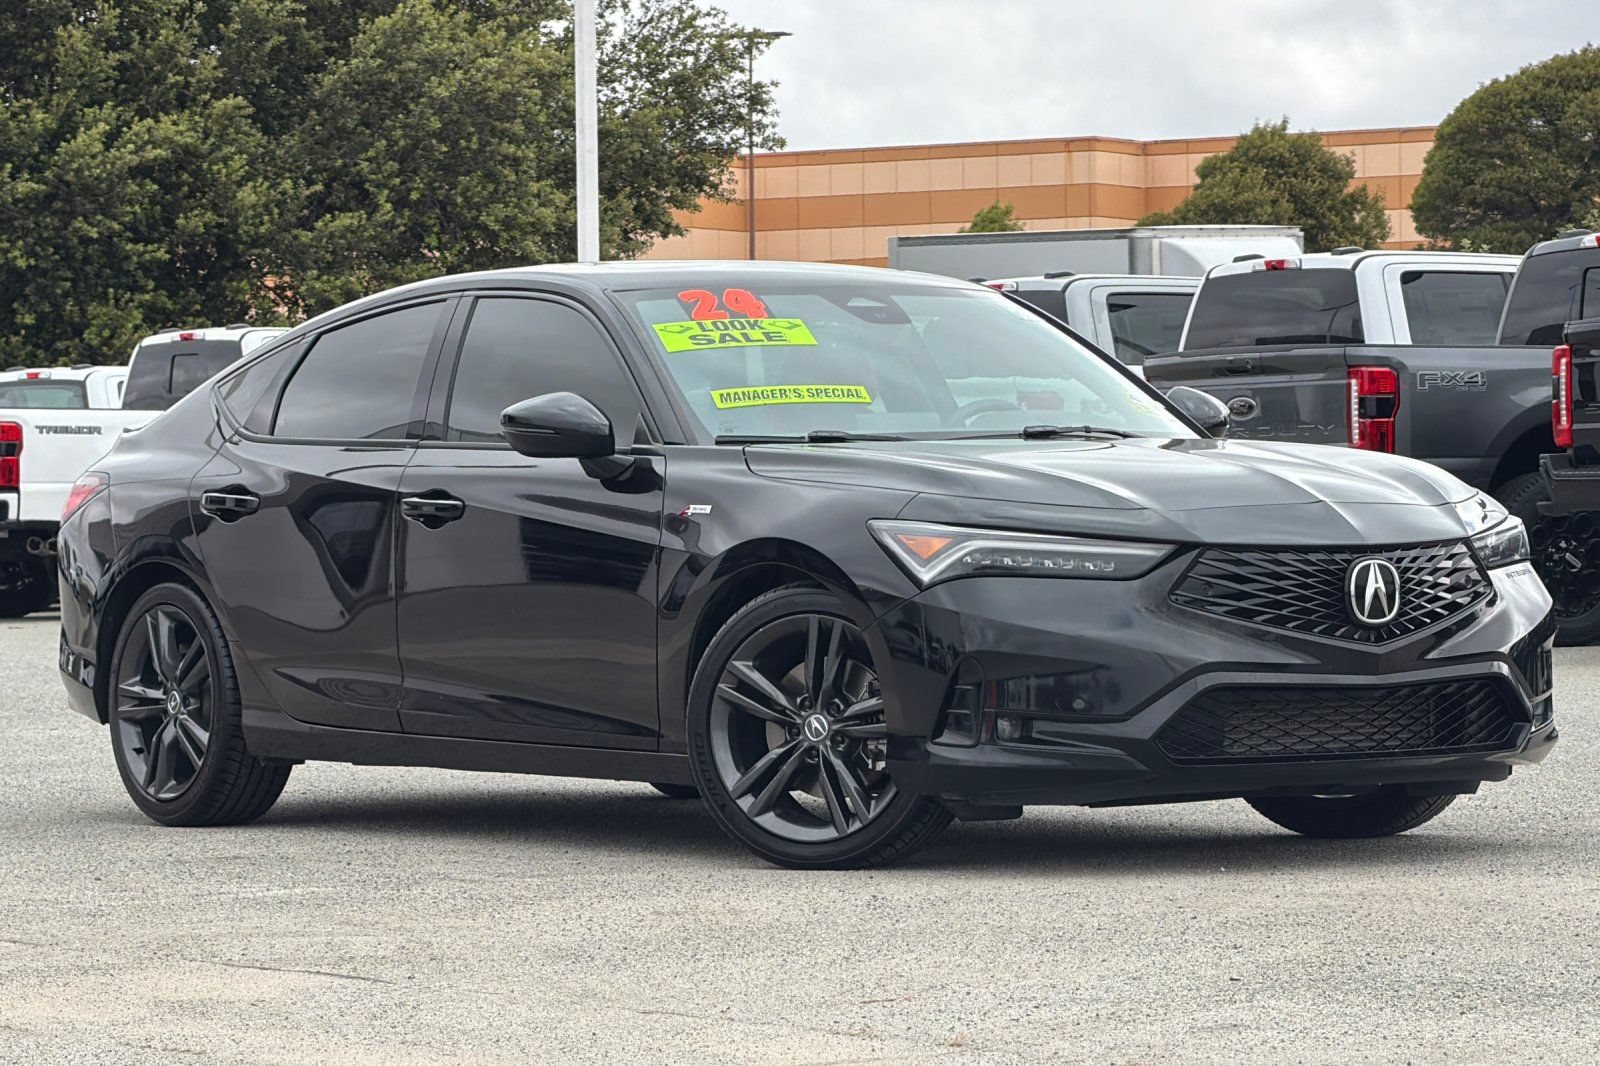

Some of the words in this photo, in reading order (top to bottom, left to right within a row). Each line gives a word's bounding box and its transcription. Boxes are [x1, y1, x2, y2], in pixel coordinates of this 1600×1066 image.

[696, 319, 767, 332] LOOK
[688, 331, 787, 346] SALE
[1417, 371, 1487, 391] FX4
[719, 388, 803, 404] MANAGER'S
[807, 387, 865, 399] SPECIAL
[35, 425, 102, 435] TREMOR
